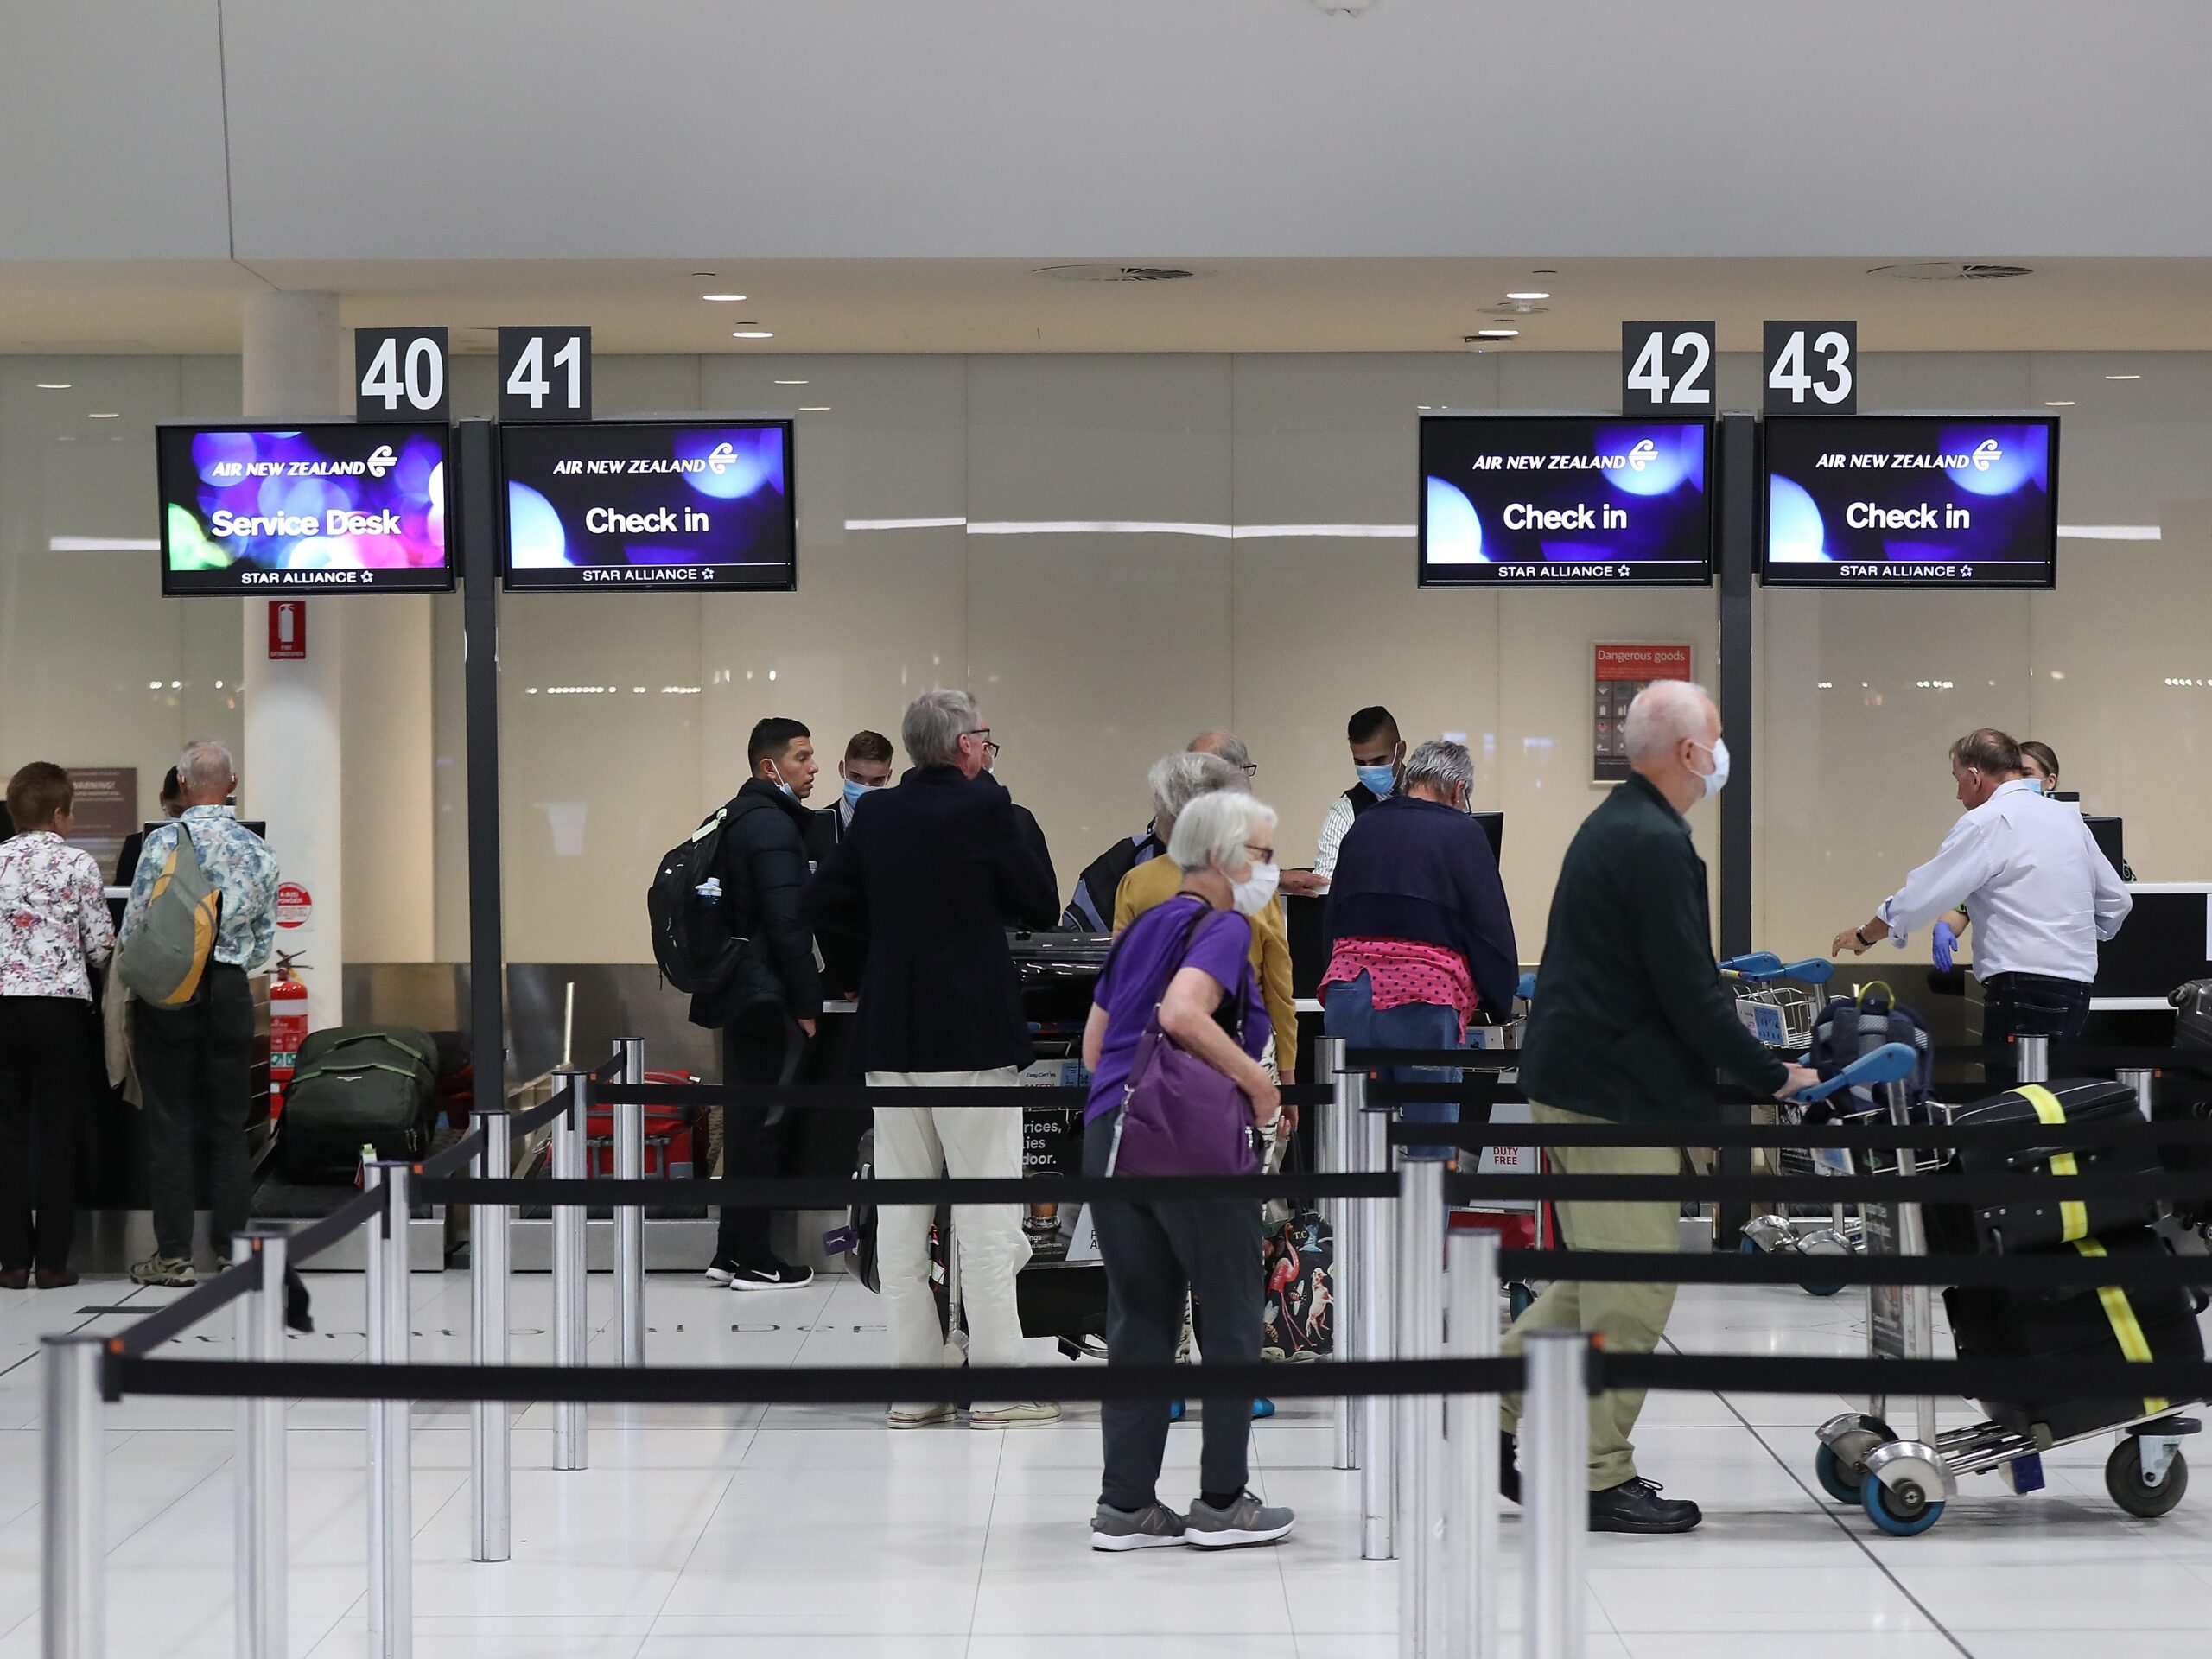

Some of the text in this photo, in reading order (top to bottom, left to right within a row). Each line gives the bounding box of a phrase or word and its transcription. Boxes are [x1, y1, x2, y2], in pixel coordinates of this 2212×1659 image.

[361, 338, 443, 410] 40
[506, 337, 581, 409] 41
[1627, 331, 1710, 404] 42
[1769, 331, 1853, 404] 43
[212, 461, 366, 476] AIR NEW ZEALAND
[553, 459, 706, 474] AIR NEW ZEALAND
[1472, 455, 1626, 470] AIR NEW ZEALAND
[1815, 454, 1970, 468] AIR NEW ZEALAND
[211, 509, 402, 537] Service Desk
[585, 506, 709, 534] Check in
[1503, 503, 1628, 530] Check in
[1846, 502, 1970, 529] Check in
[241, 571, 357, 584] STAR ALLIANCE
[582, 569, 697, 582] STAR ALLIANCE
[1498, 565, 1613, 577] STAR ALLIANCE
[1840, 565, 1955, 577] STAR ALLIANCE
[1598, 650, 1686, 663] Dangerous goods
[1023, 1120, 1062, 1134] rices,
[1493, 1147, 1519, 1156] DUTY
[1494, 1156, 1517, 1166] FREE
[1026, 1234, 1042, 1243] ings
